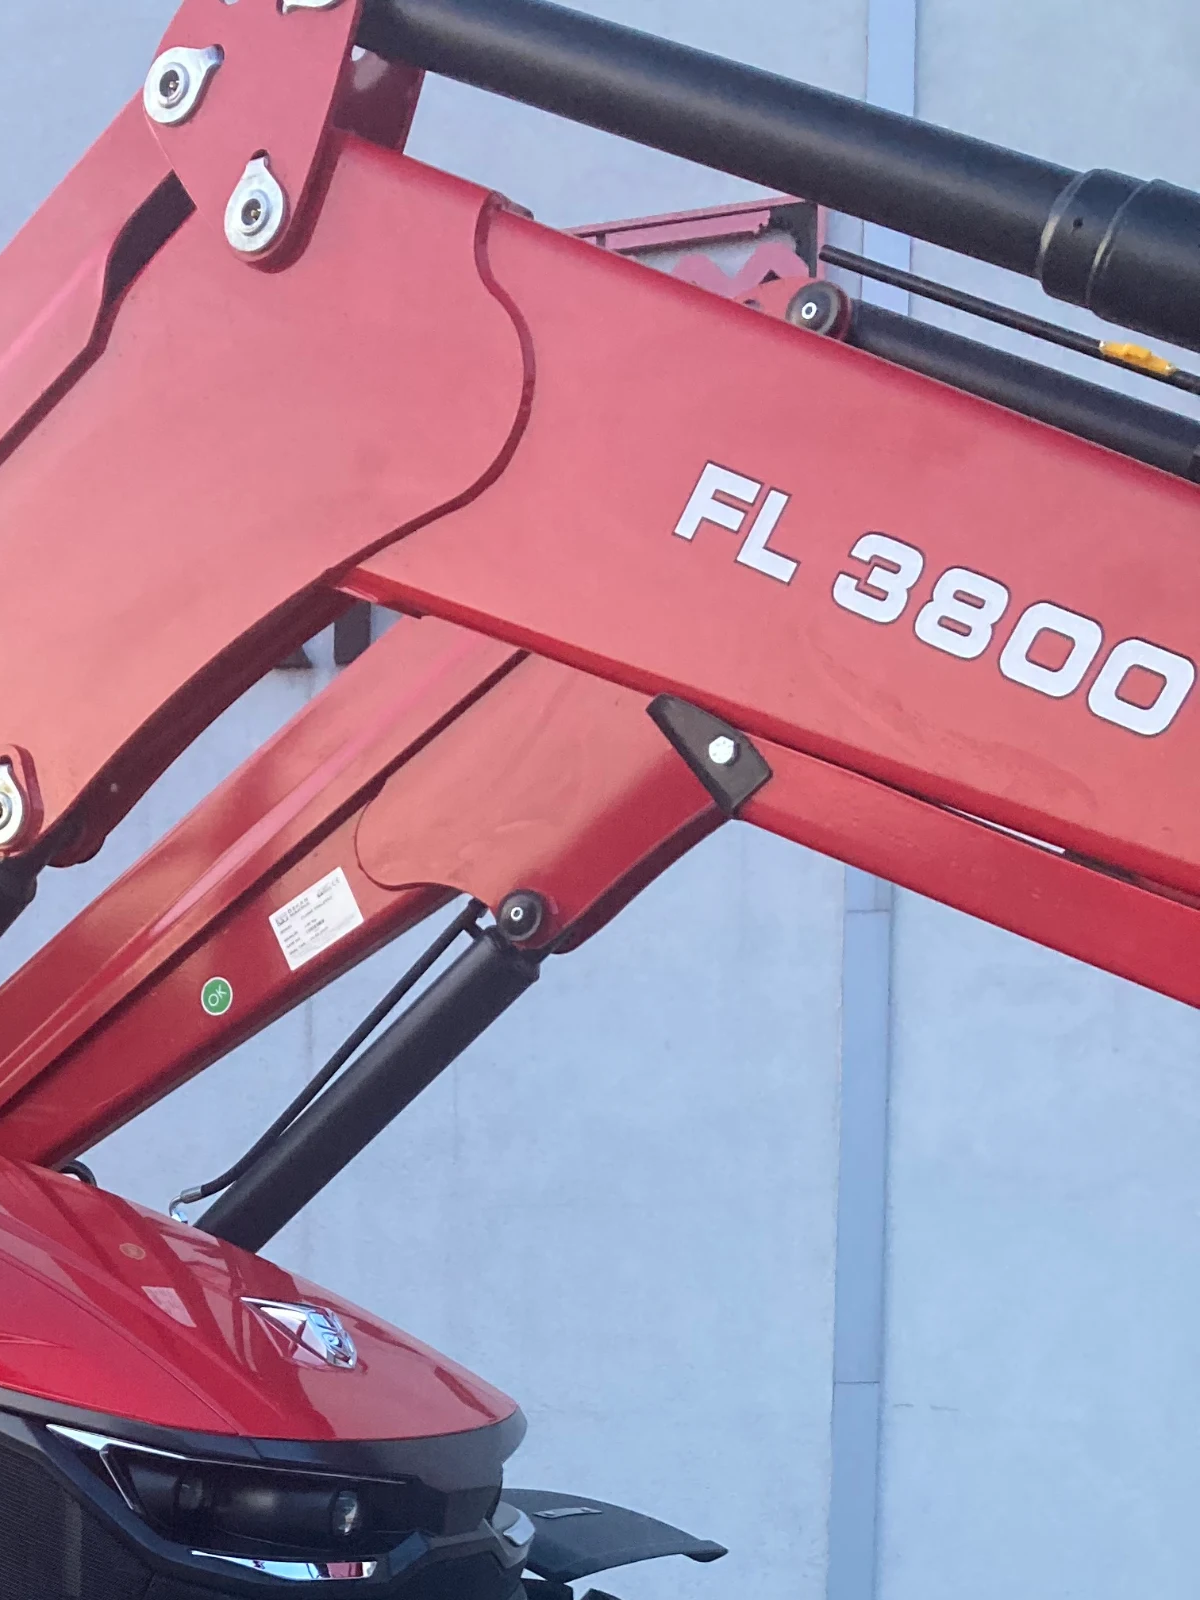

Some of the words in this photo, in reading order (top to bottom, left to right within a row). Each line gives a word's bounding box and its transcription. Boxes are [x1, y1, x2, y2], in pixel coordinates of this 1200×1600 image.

[673, 460, 801, 586] FL
[832, 531, 1197, 737] 3800
[208, 985, 227, 1007] OK
